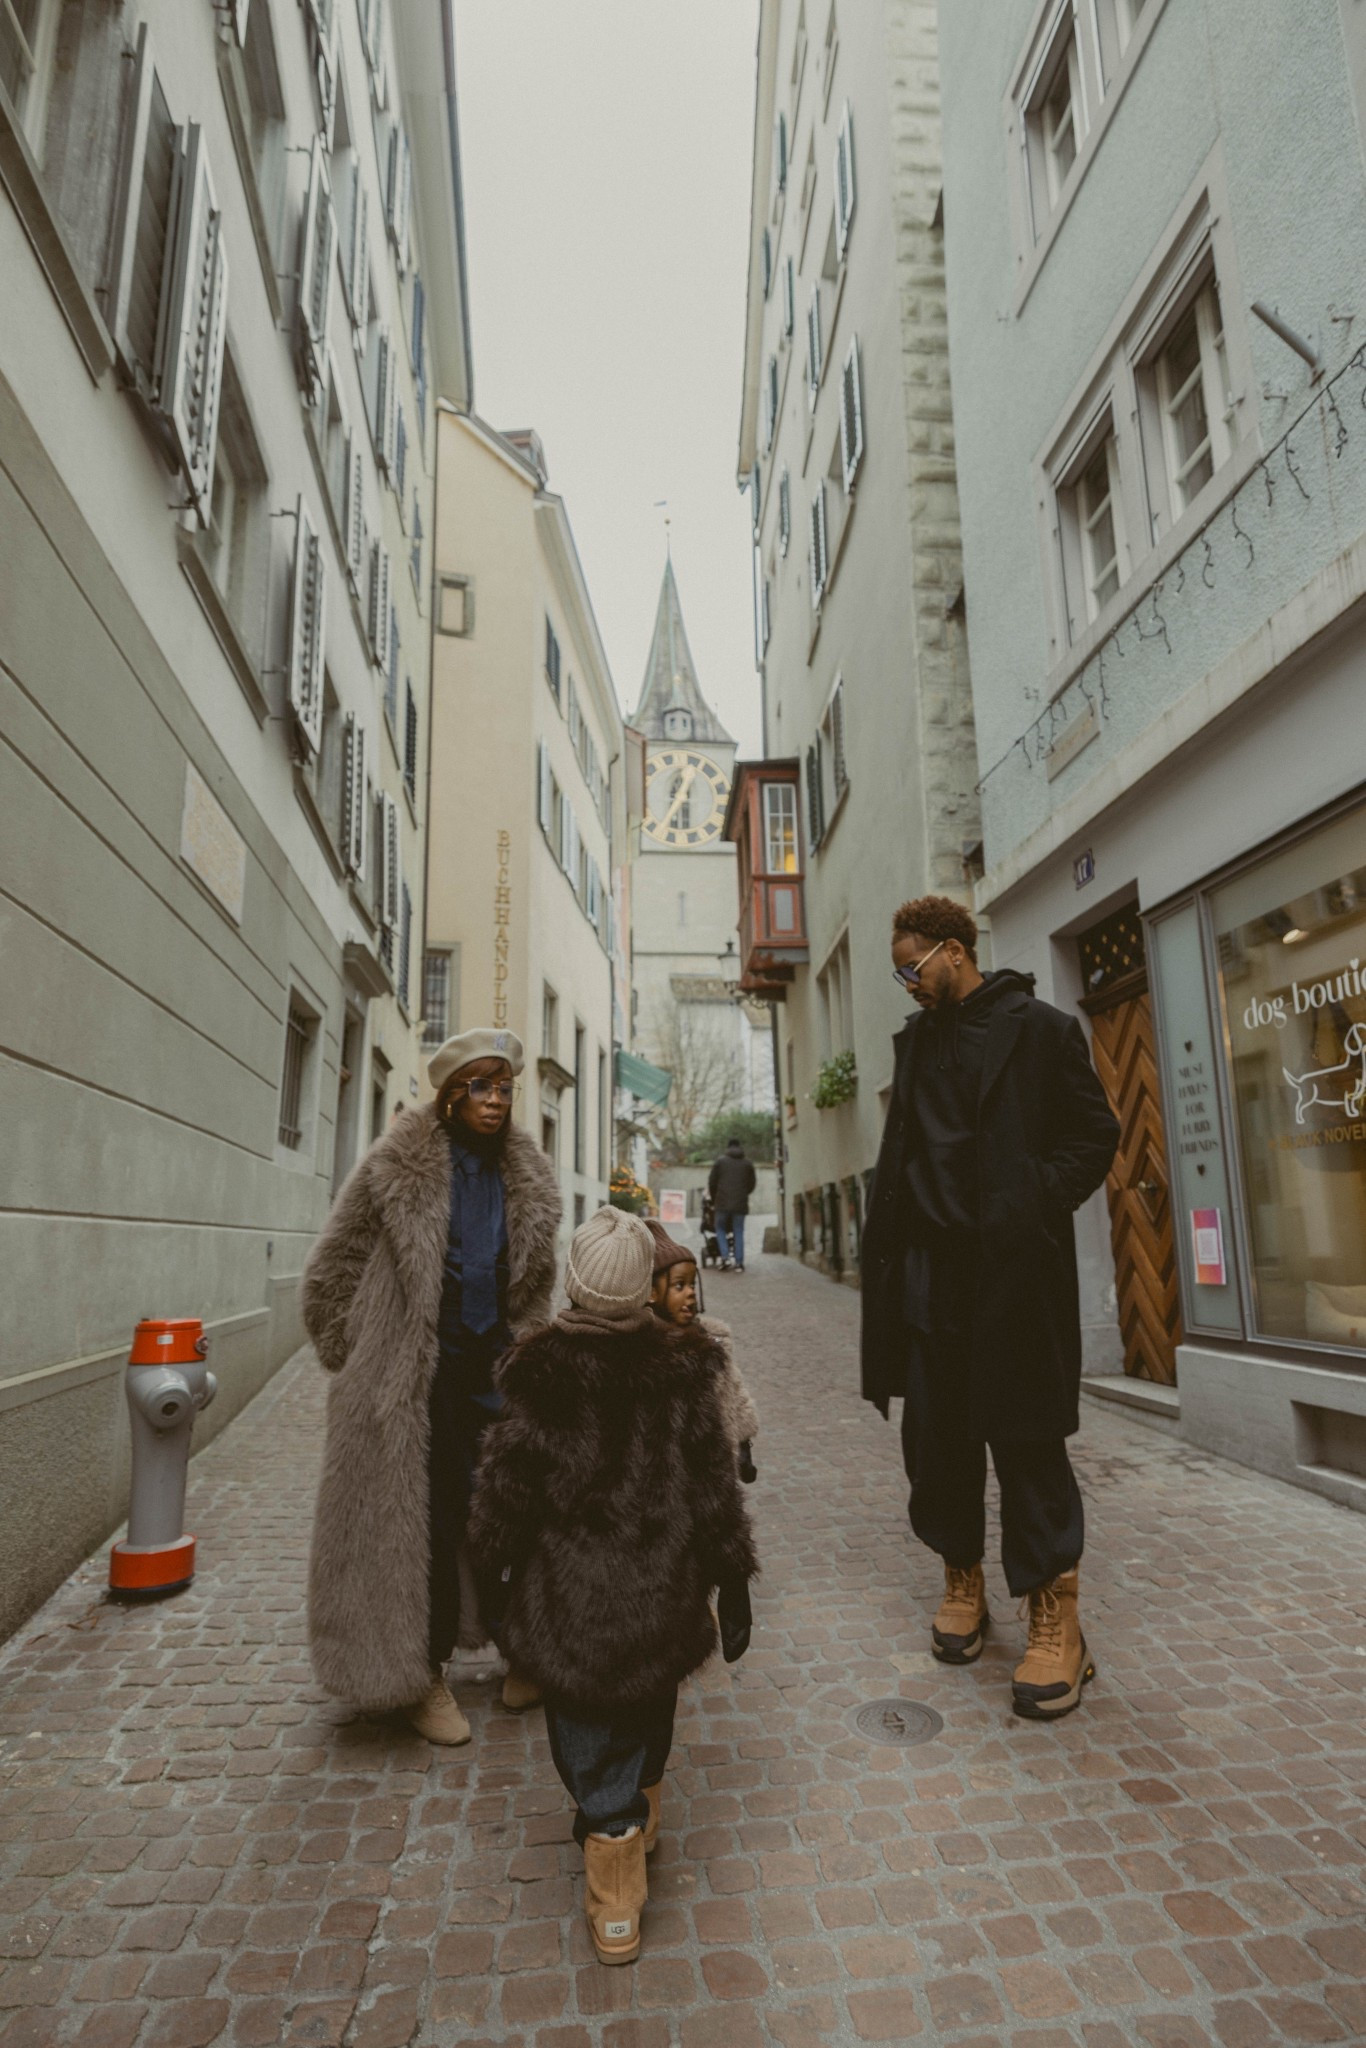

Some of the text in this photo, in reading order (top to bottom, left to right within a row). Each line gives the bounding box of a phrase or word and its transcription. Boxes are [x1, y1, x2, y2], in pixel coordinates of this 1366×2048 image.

[1077, 856, 1088, 882] 17
[1185, 1102, 1205, 1116] FOR
[1180, 1138, 1218, 1155] FRIENDS
[610, 1925, 626, 1935] UGG
